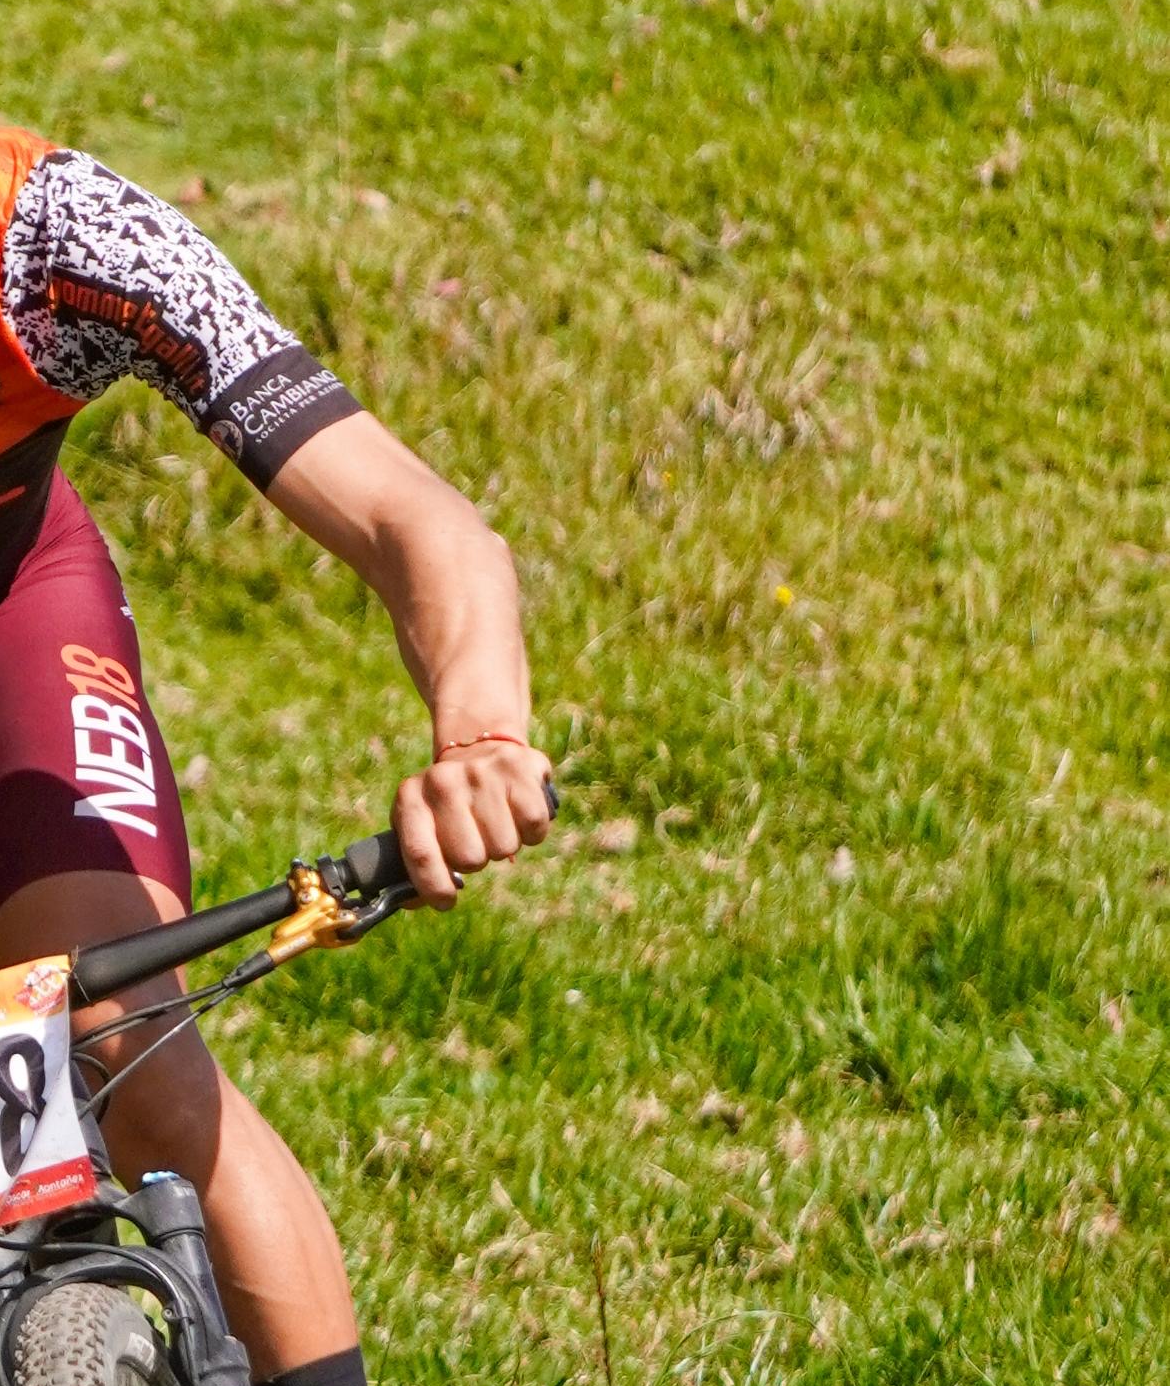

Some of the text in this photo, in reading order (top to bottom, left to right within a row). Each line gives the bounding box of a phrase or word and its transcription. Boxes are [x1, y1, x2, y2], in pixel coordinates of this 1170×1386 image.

[230, 374, 293, 421] BANCA
[244, 369, 337, 436] CAMBIANO
[60, 644, 157, 837] NEB18
